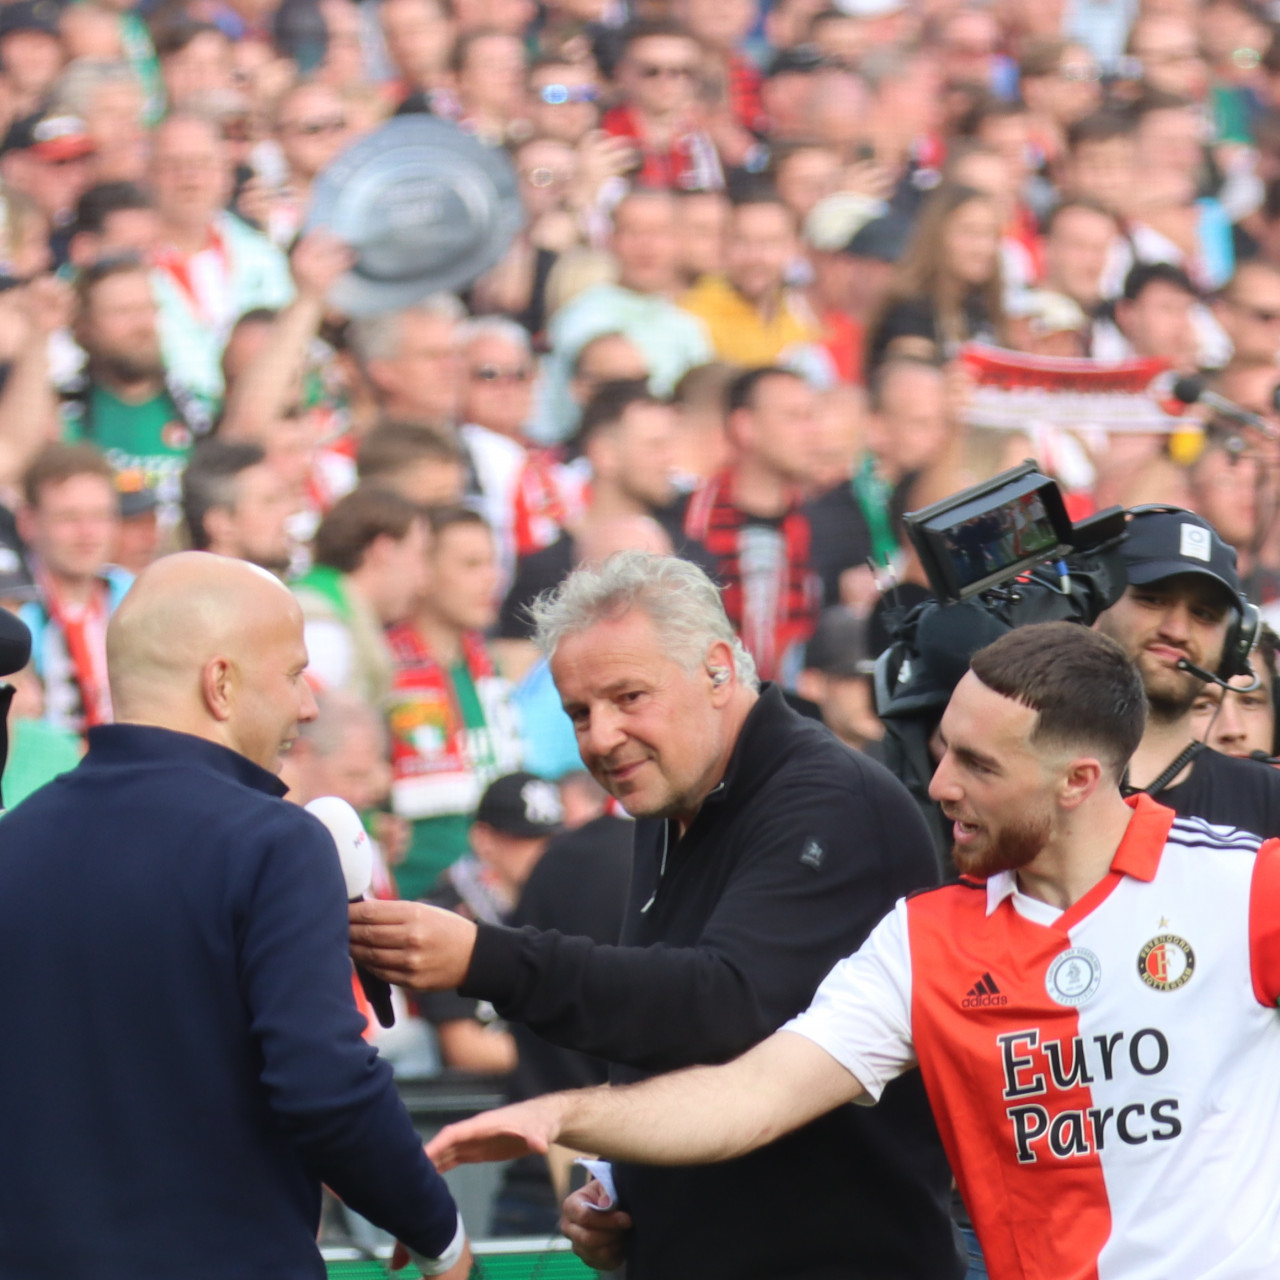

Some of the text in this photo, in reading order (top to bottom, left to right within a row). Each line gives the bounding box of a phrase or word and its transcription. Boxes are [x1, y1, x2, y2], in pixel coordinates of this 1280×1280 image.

[961, 995, 1008, 1009] adidas
[996, 1027, 1169, 1100] Euro
[1006, 1098, 1183, 1164] Parcs
